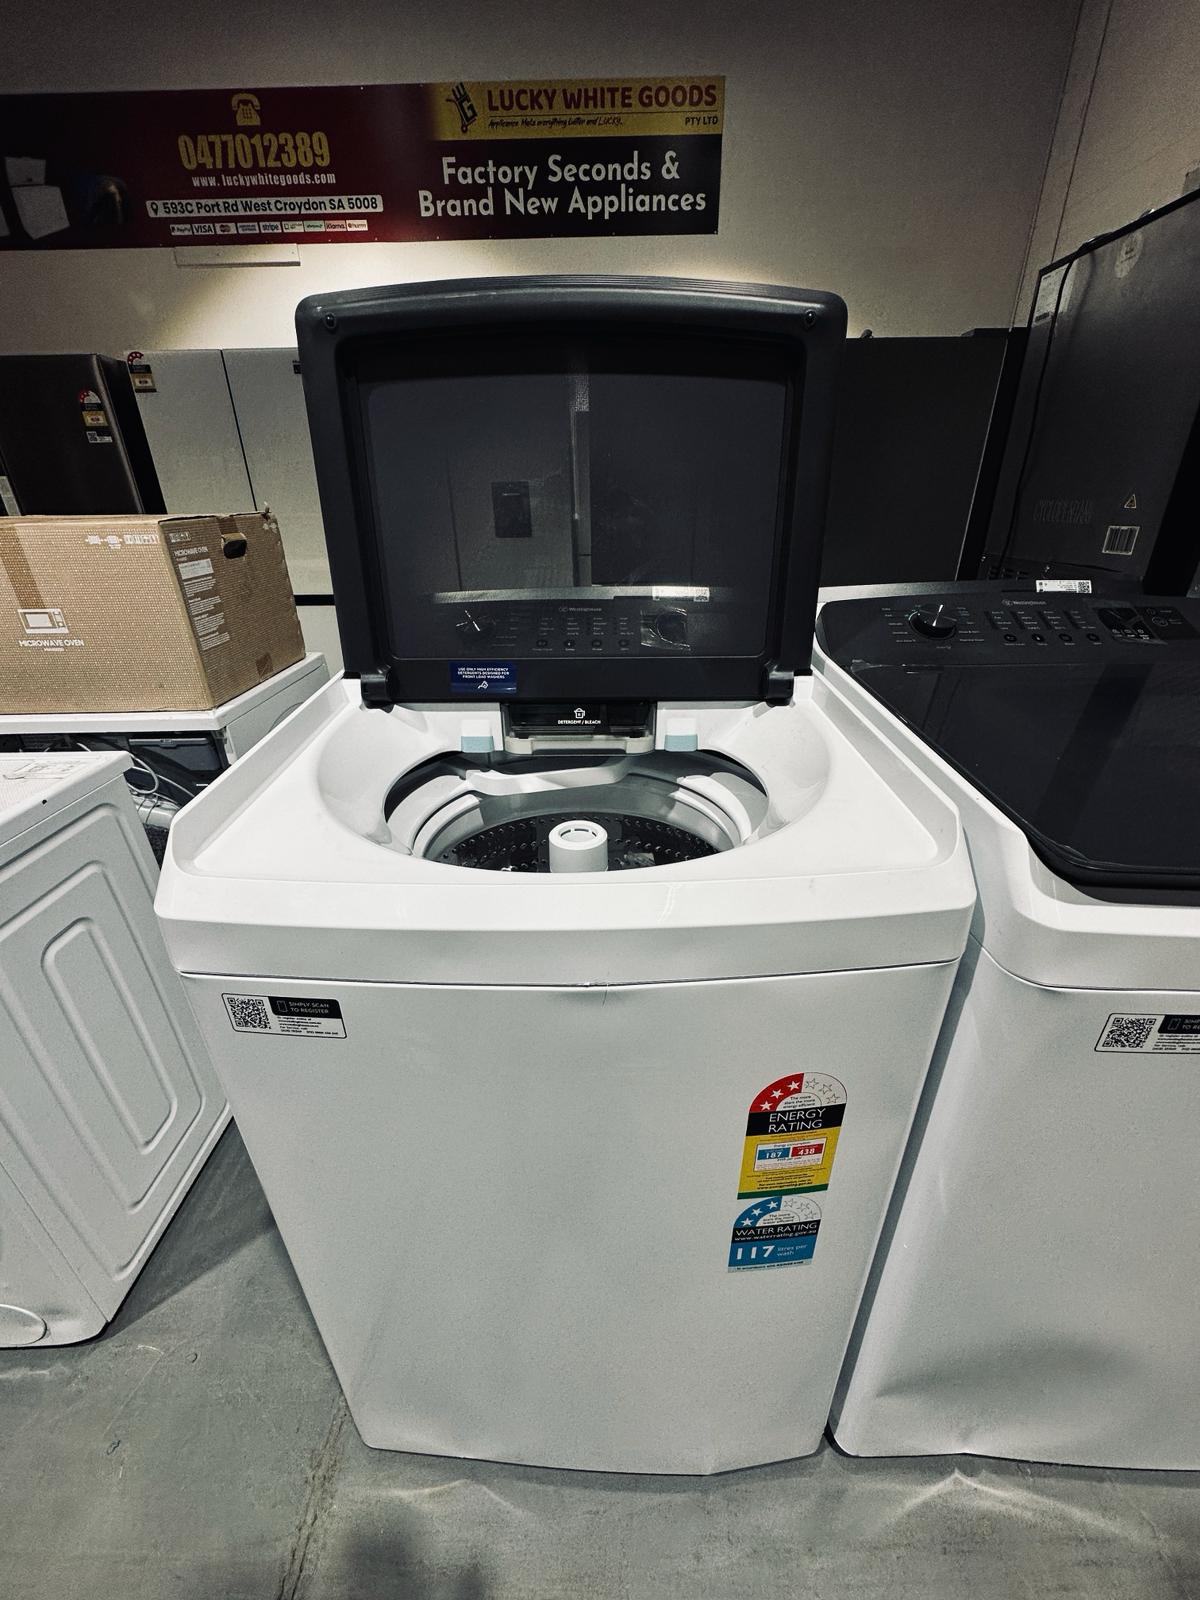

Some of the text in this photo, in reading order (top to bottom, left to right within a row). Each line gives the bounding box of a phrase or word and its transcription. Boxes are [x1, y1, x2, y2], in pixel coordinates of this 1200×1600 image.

[488, 85, 717, 111] LUCKY WHITE GOODS
[685, 116, 718, 126] PTY LTD
[177, 131, 330, 170] 0477012389
[442, 150, 680, 190] Factory Seconds &
[163, 196, 378, 214] 593C Port Rd West Croydon SA 5008
[418, 183, 707, 220] Brand New Appliances
[194, 224, 213, 233] VISA
[262, 223, 279, 231] stripe
[18, 639, 63, 647] MICROWAVE
[769, 1108, 826, 1123] ENERGY
[768, 1119, 823, 1133] RATING
[766, 1151, 783, 1159] 187
[736, 1221, 817, 1236] WATER RATING
